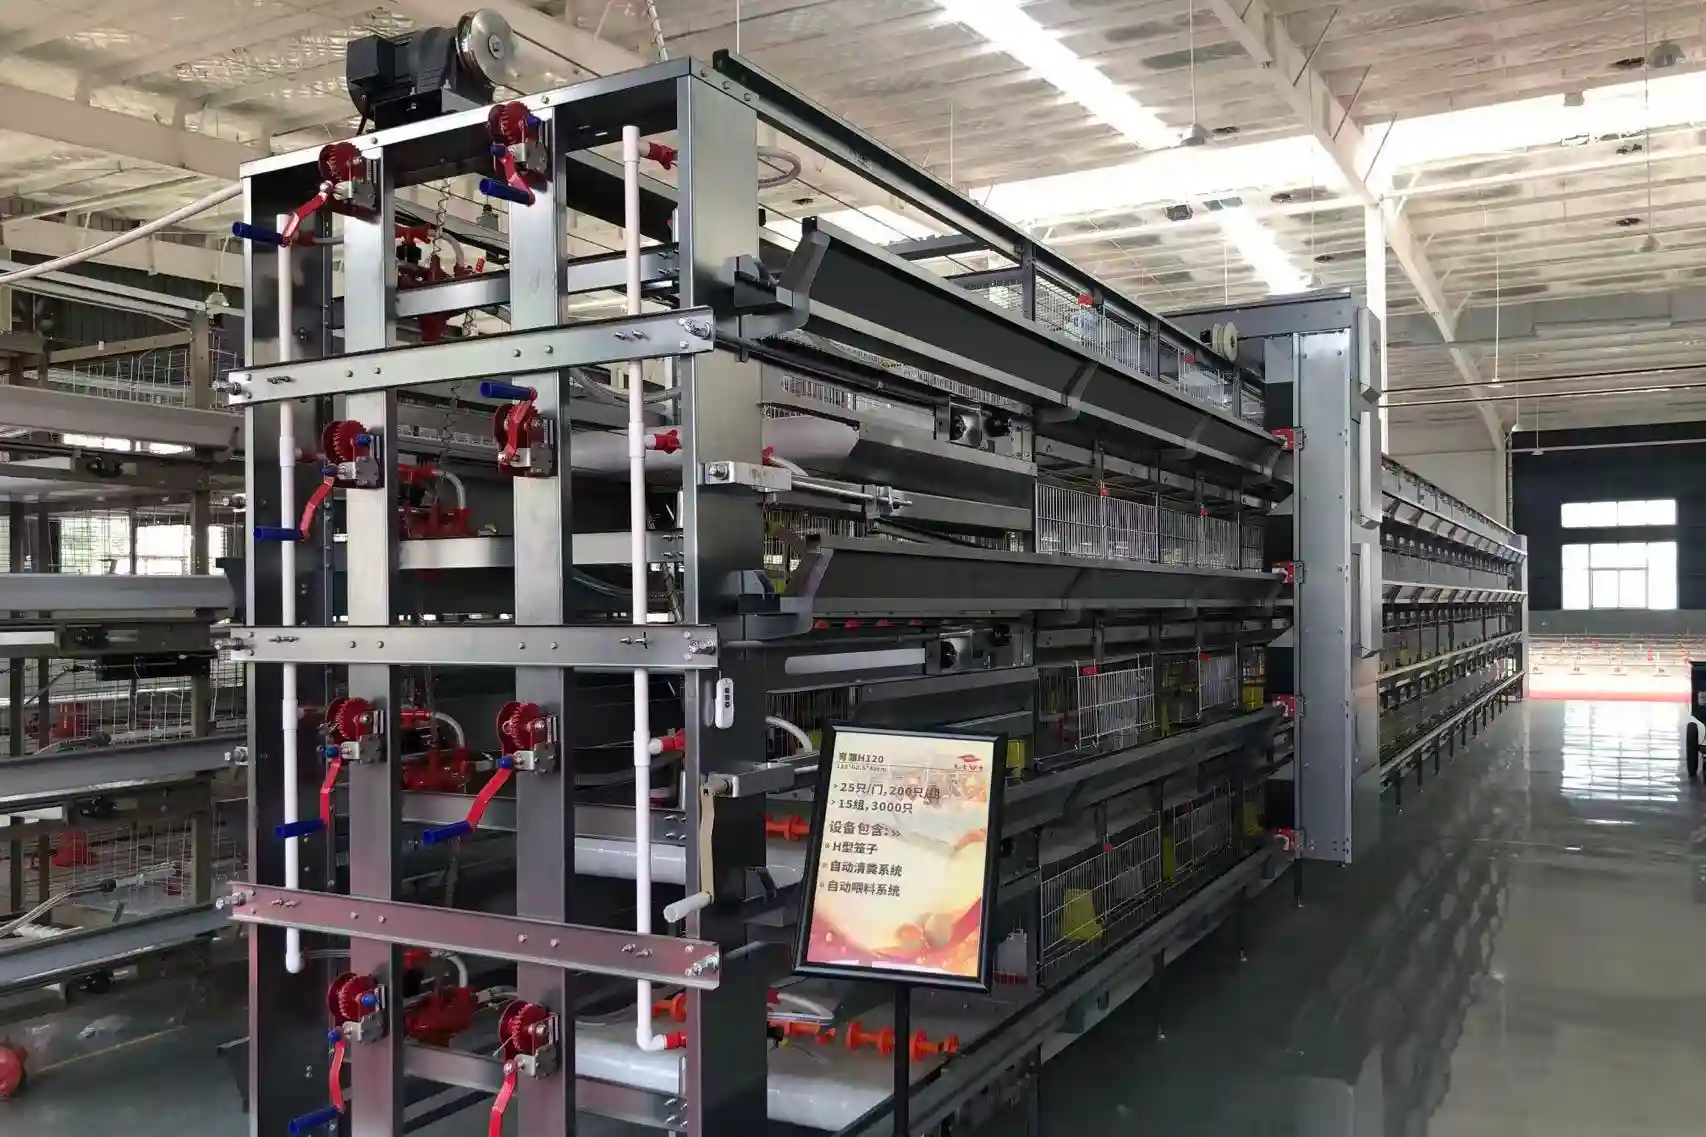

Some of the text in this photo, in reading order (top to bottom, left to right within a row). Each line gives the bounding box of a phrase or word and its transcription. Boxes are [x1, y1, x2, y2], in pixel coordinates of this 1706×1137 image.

[832, 841, 878, 854] H型笼子
[829, 860, 902, 877] 自动清粪系统
[827, 880, 900, 897] 自动喂料系统
